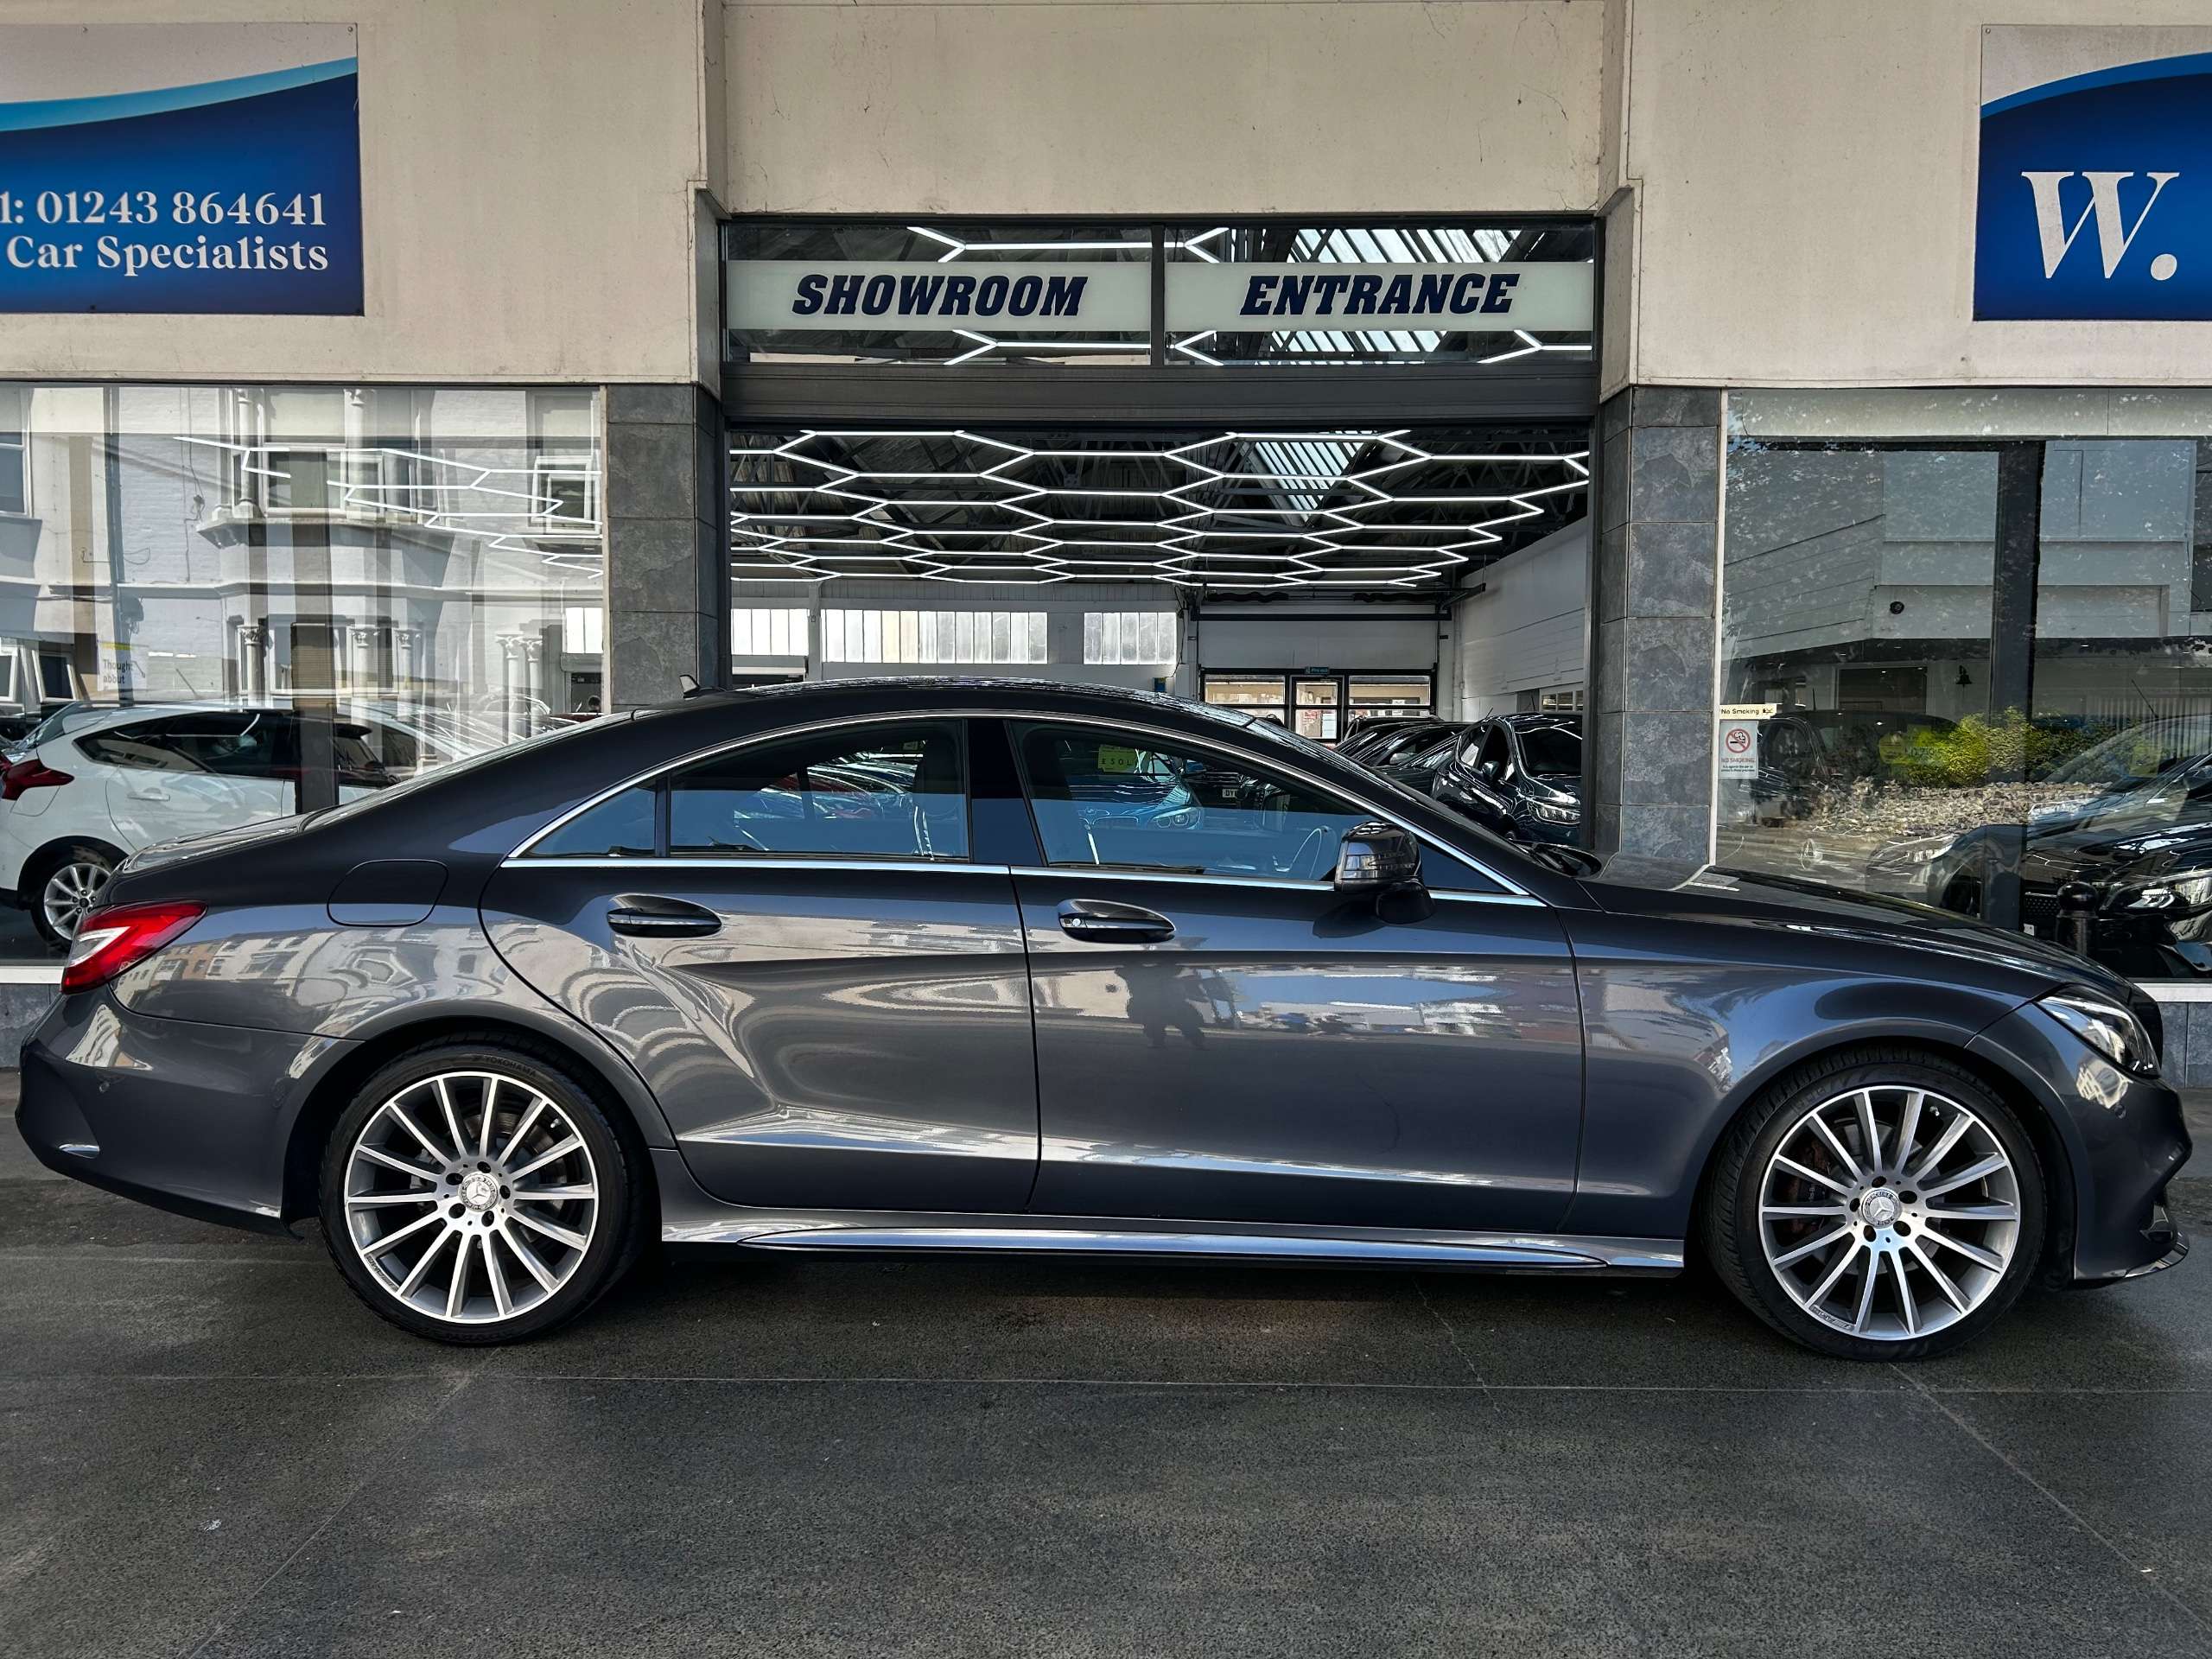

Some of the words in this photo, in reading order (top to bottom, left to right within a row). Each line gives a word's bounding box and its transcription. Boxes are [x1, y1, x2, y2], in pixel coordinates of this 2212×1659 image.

[36, 191, 158, 224] 01243
[174, 191, 327, 226] 864641
[2020, 171, 2180, 281] W.
[7, 235, 83, 268] Car
[97, 235, 328, 276] Specialists
[791, 274, 1089, 317] SHOWROOM
[1240, 273, 1521, 315] ENTRANCE
[103, 674, 125, 683] about
[484, 1055, 537, 1077] YOKOHAMA
